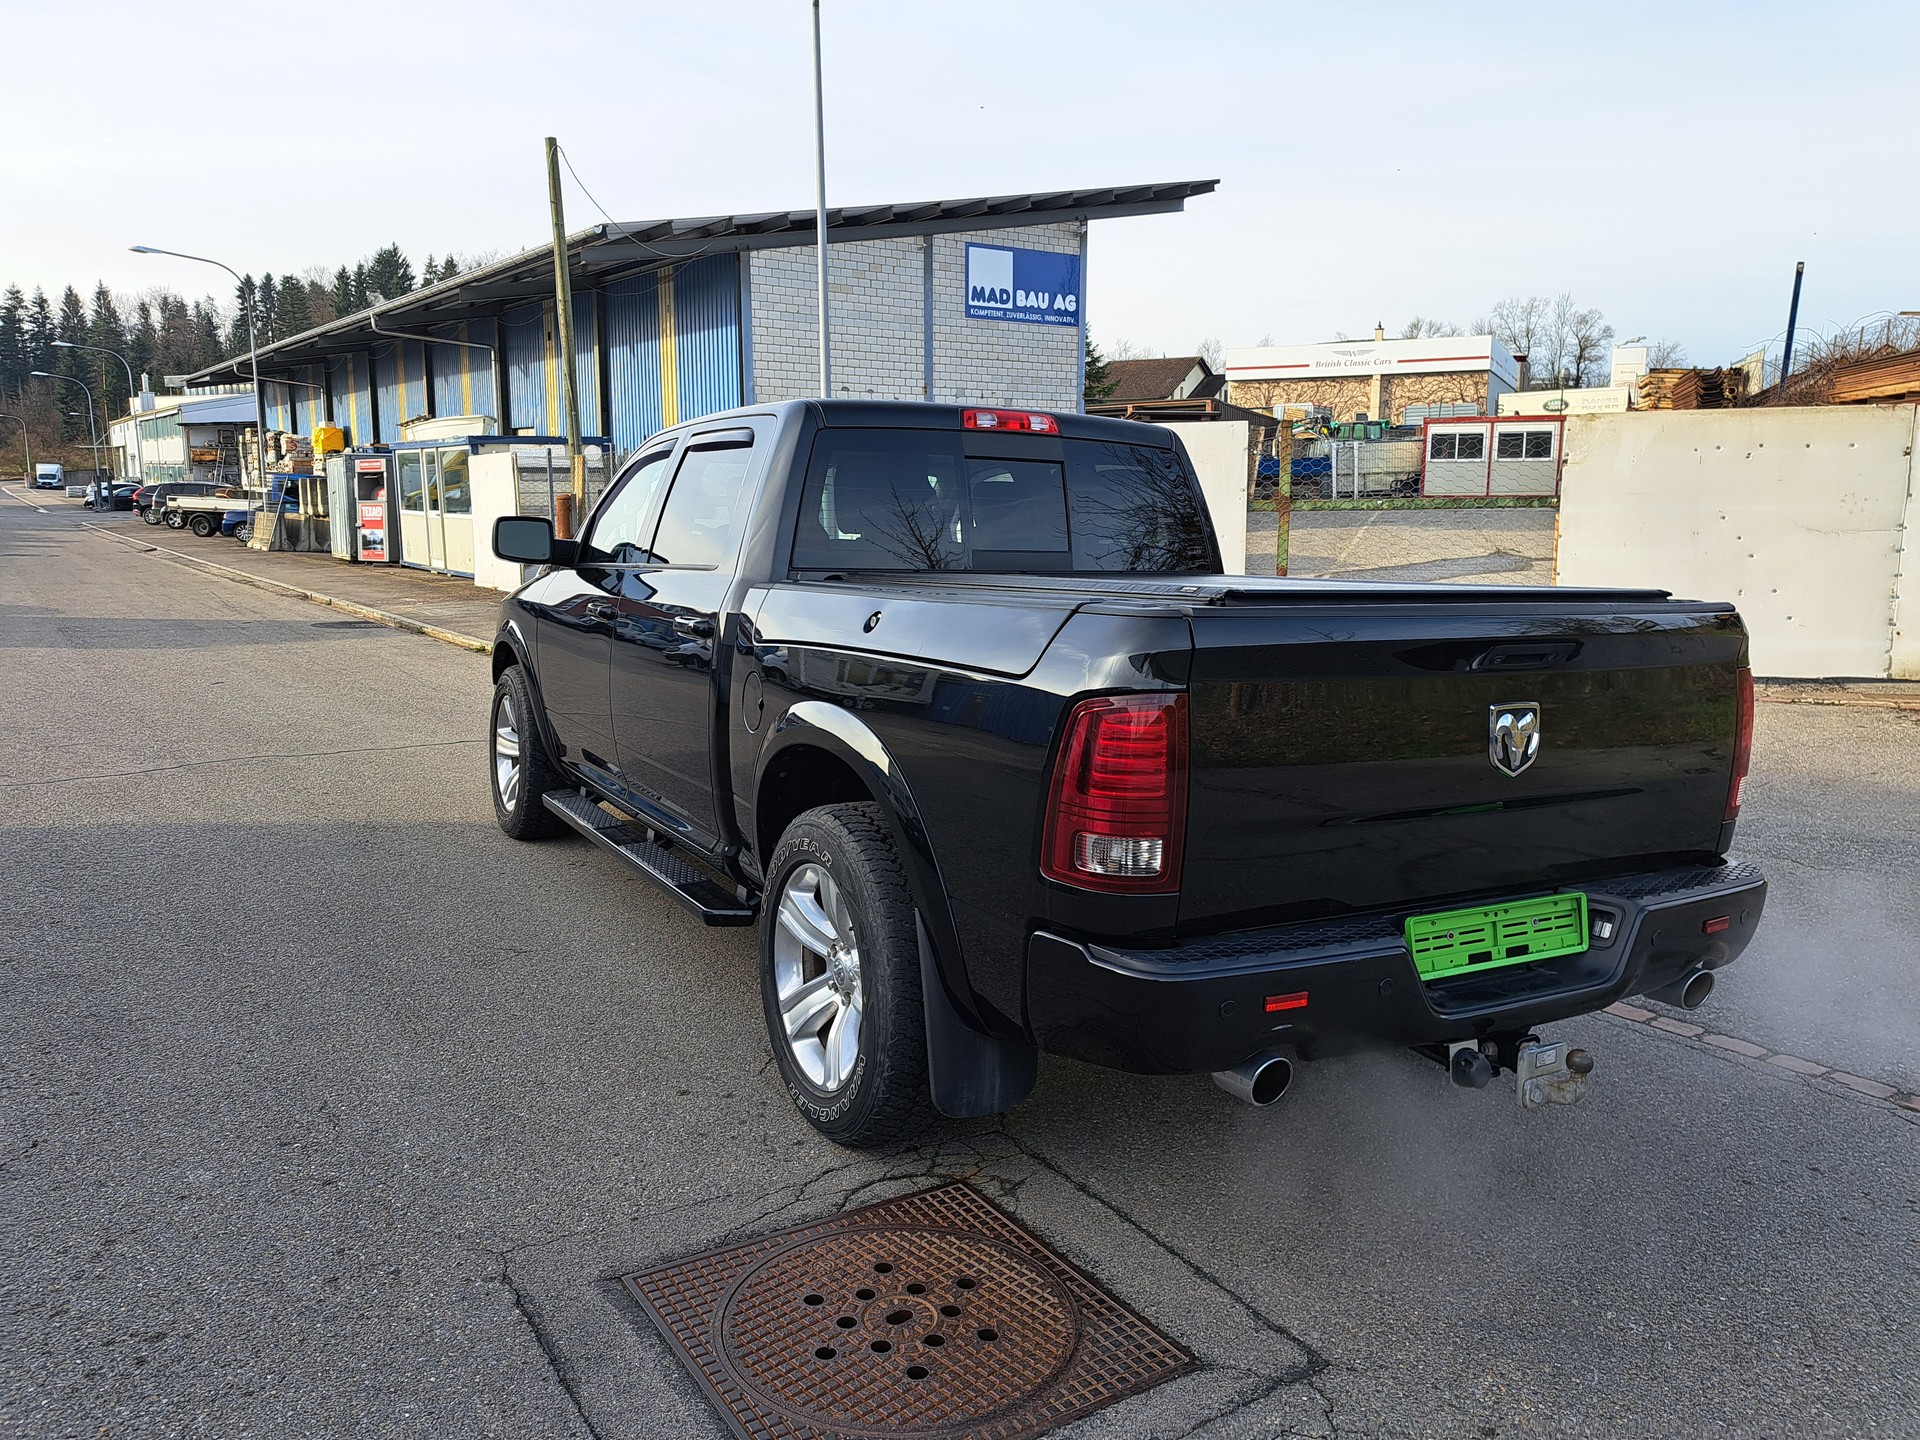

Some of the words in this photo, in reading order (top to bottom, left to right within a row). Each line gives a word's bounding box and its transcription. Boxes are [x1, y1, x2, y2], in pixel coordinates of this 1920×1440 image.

[971, 285, 1011, 305] MAD
[1016, 289, 1049, 310] BAU
[1053, 293, 1076, 312] AG
[1315, 360, 1341, 368] British
[1344, 358, 1372, 367] Classic
[1373, 358, 1392, 366] Cars
[361, 506, 383, 517] TEXAID
[760, 837, 833, 917] GOODYEAR
[788, 1054, 867, 1122] WRANGLER
